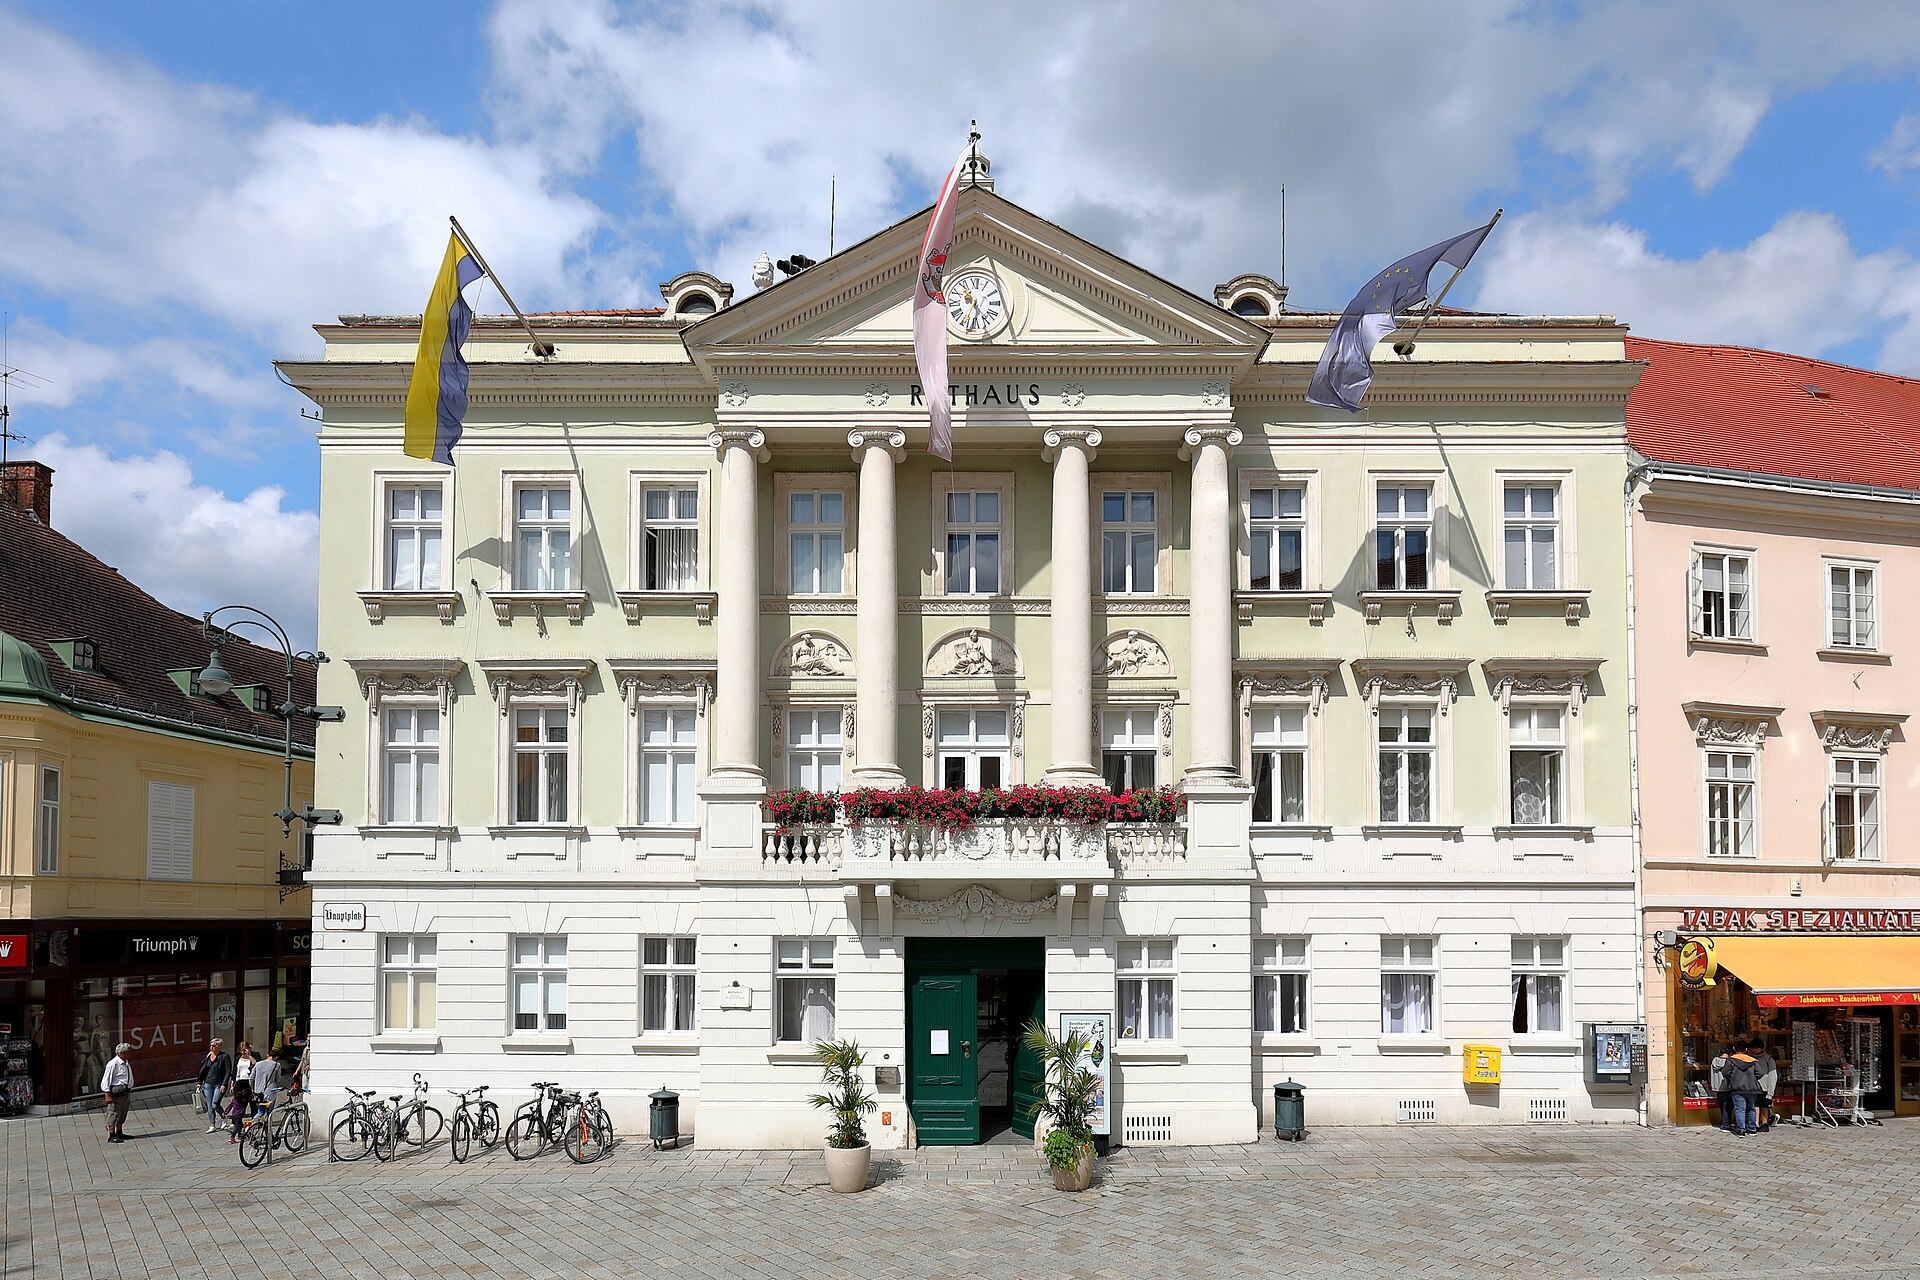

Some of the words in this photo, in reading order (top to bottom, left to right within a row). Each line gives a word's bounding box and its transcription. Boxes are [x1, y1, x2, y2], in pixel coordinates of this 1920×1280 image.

[910, 384, 1040, 406] RTHAUS
[1683, 909, 1757, 927] TABAK
[132, 937, 187, 955] Triumph
[1799, 995, 1834, 1003] Tabakwaren
[1839, 994, 1882, 1003] Raucherartikel
[215, 1014, 235, 1024] -50%
[130, 1021, 203, 1050] SALE
